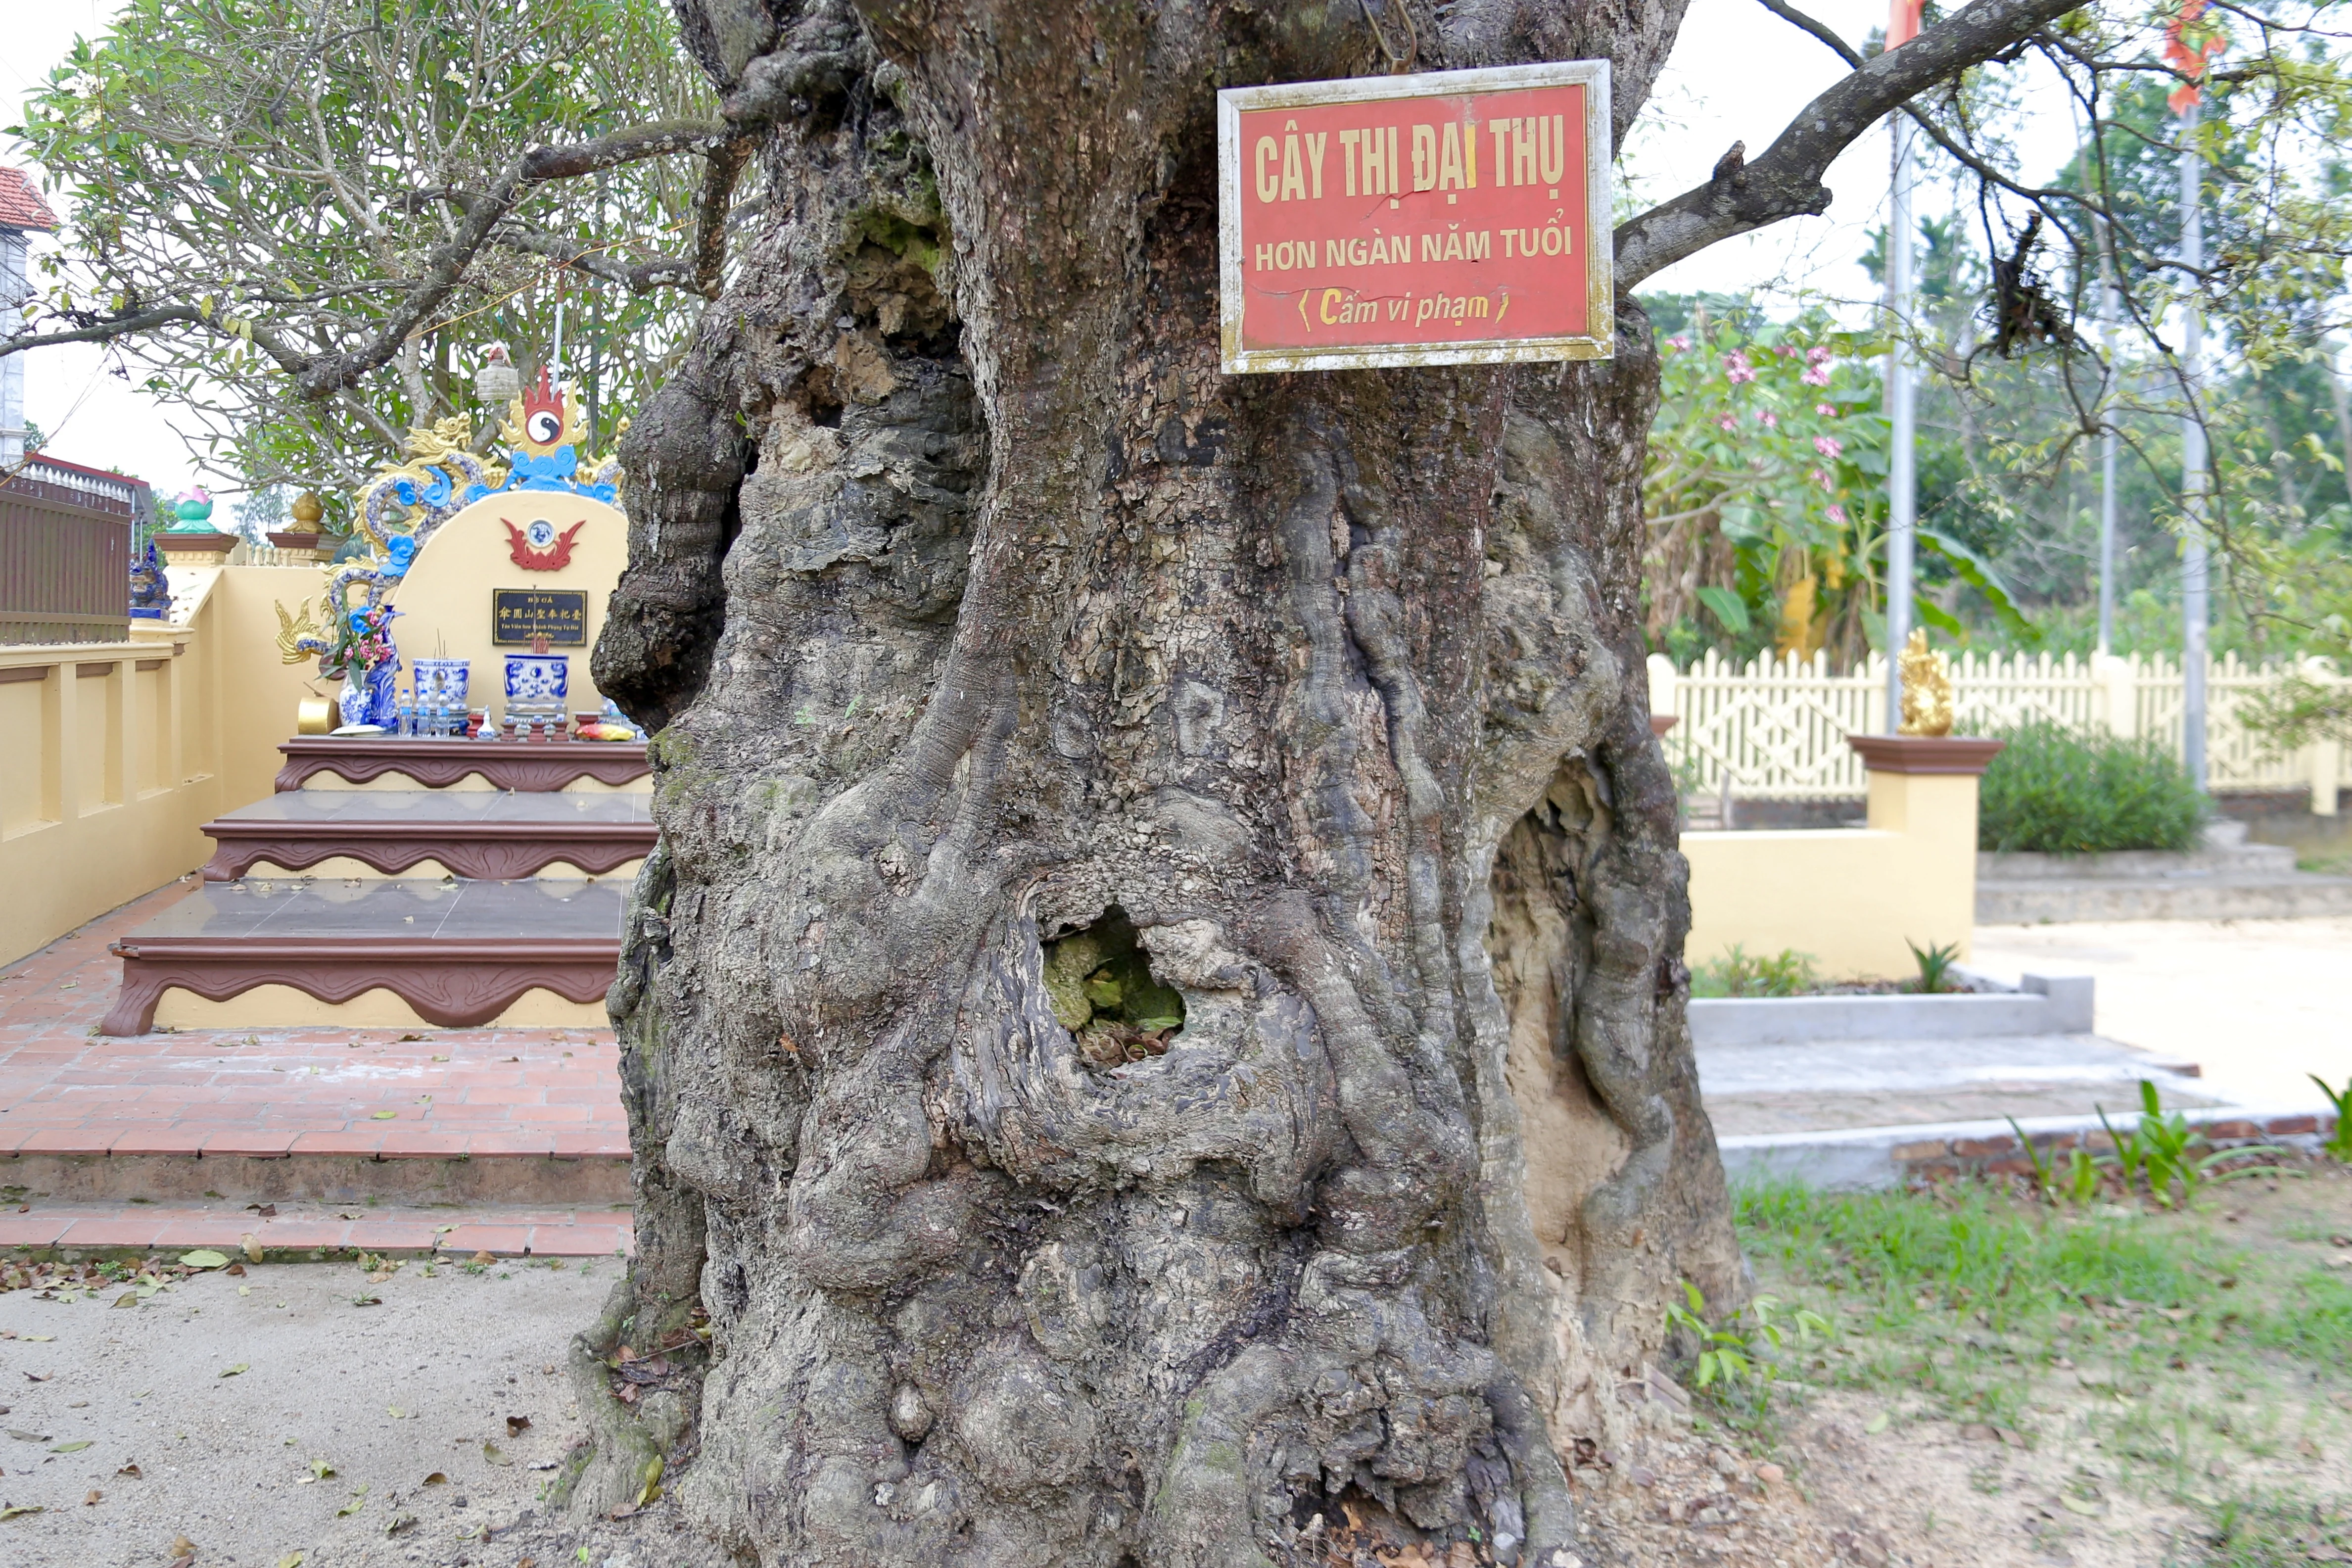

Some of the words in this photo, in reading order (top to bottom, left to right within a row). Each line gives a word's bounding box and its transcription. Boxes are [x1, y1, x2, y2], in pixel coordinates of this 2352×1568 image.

[1255, 119, 1327, 203] CÂY
[1339, 126, 1400, 210] THỊ
[1411, 122, 1477, 204] ĐẠI
[1489, 114, 1564, 199] THỤ
[1255, 239, 1316, 271] HƠN
[1325, 228, 1411, 268] NGÀN
[1421, 224, 1491, 262] NĂM
[1500, 208, 1571, 258] TUỔI
[1387, 291, 1411, 321] vi
